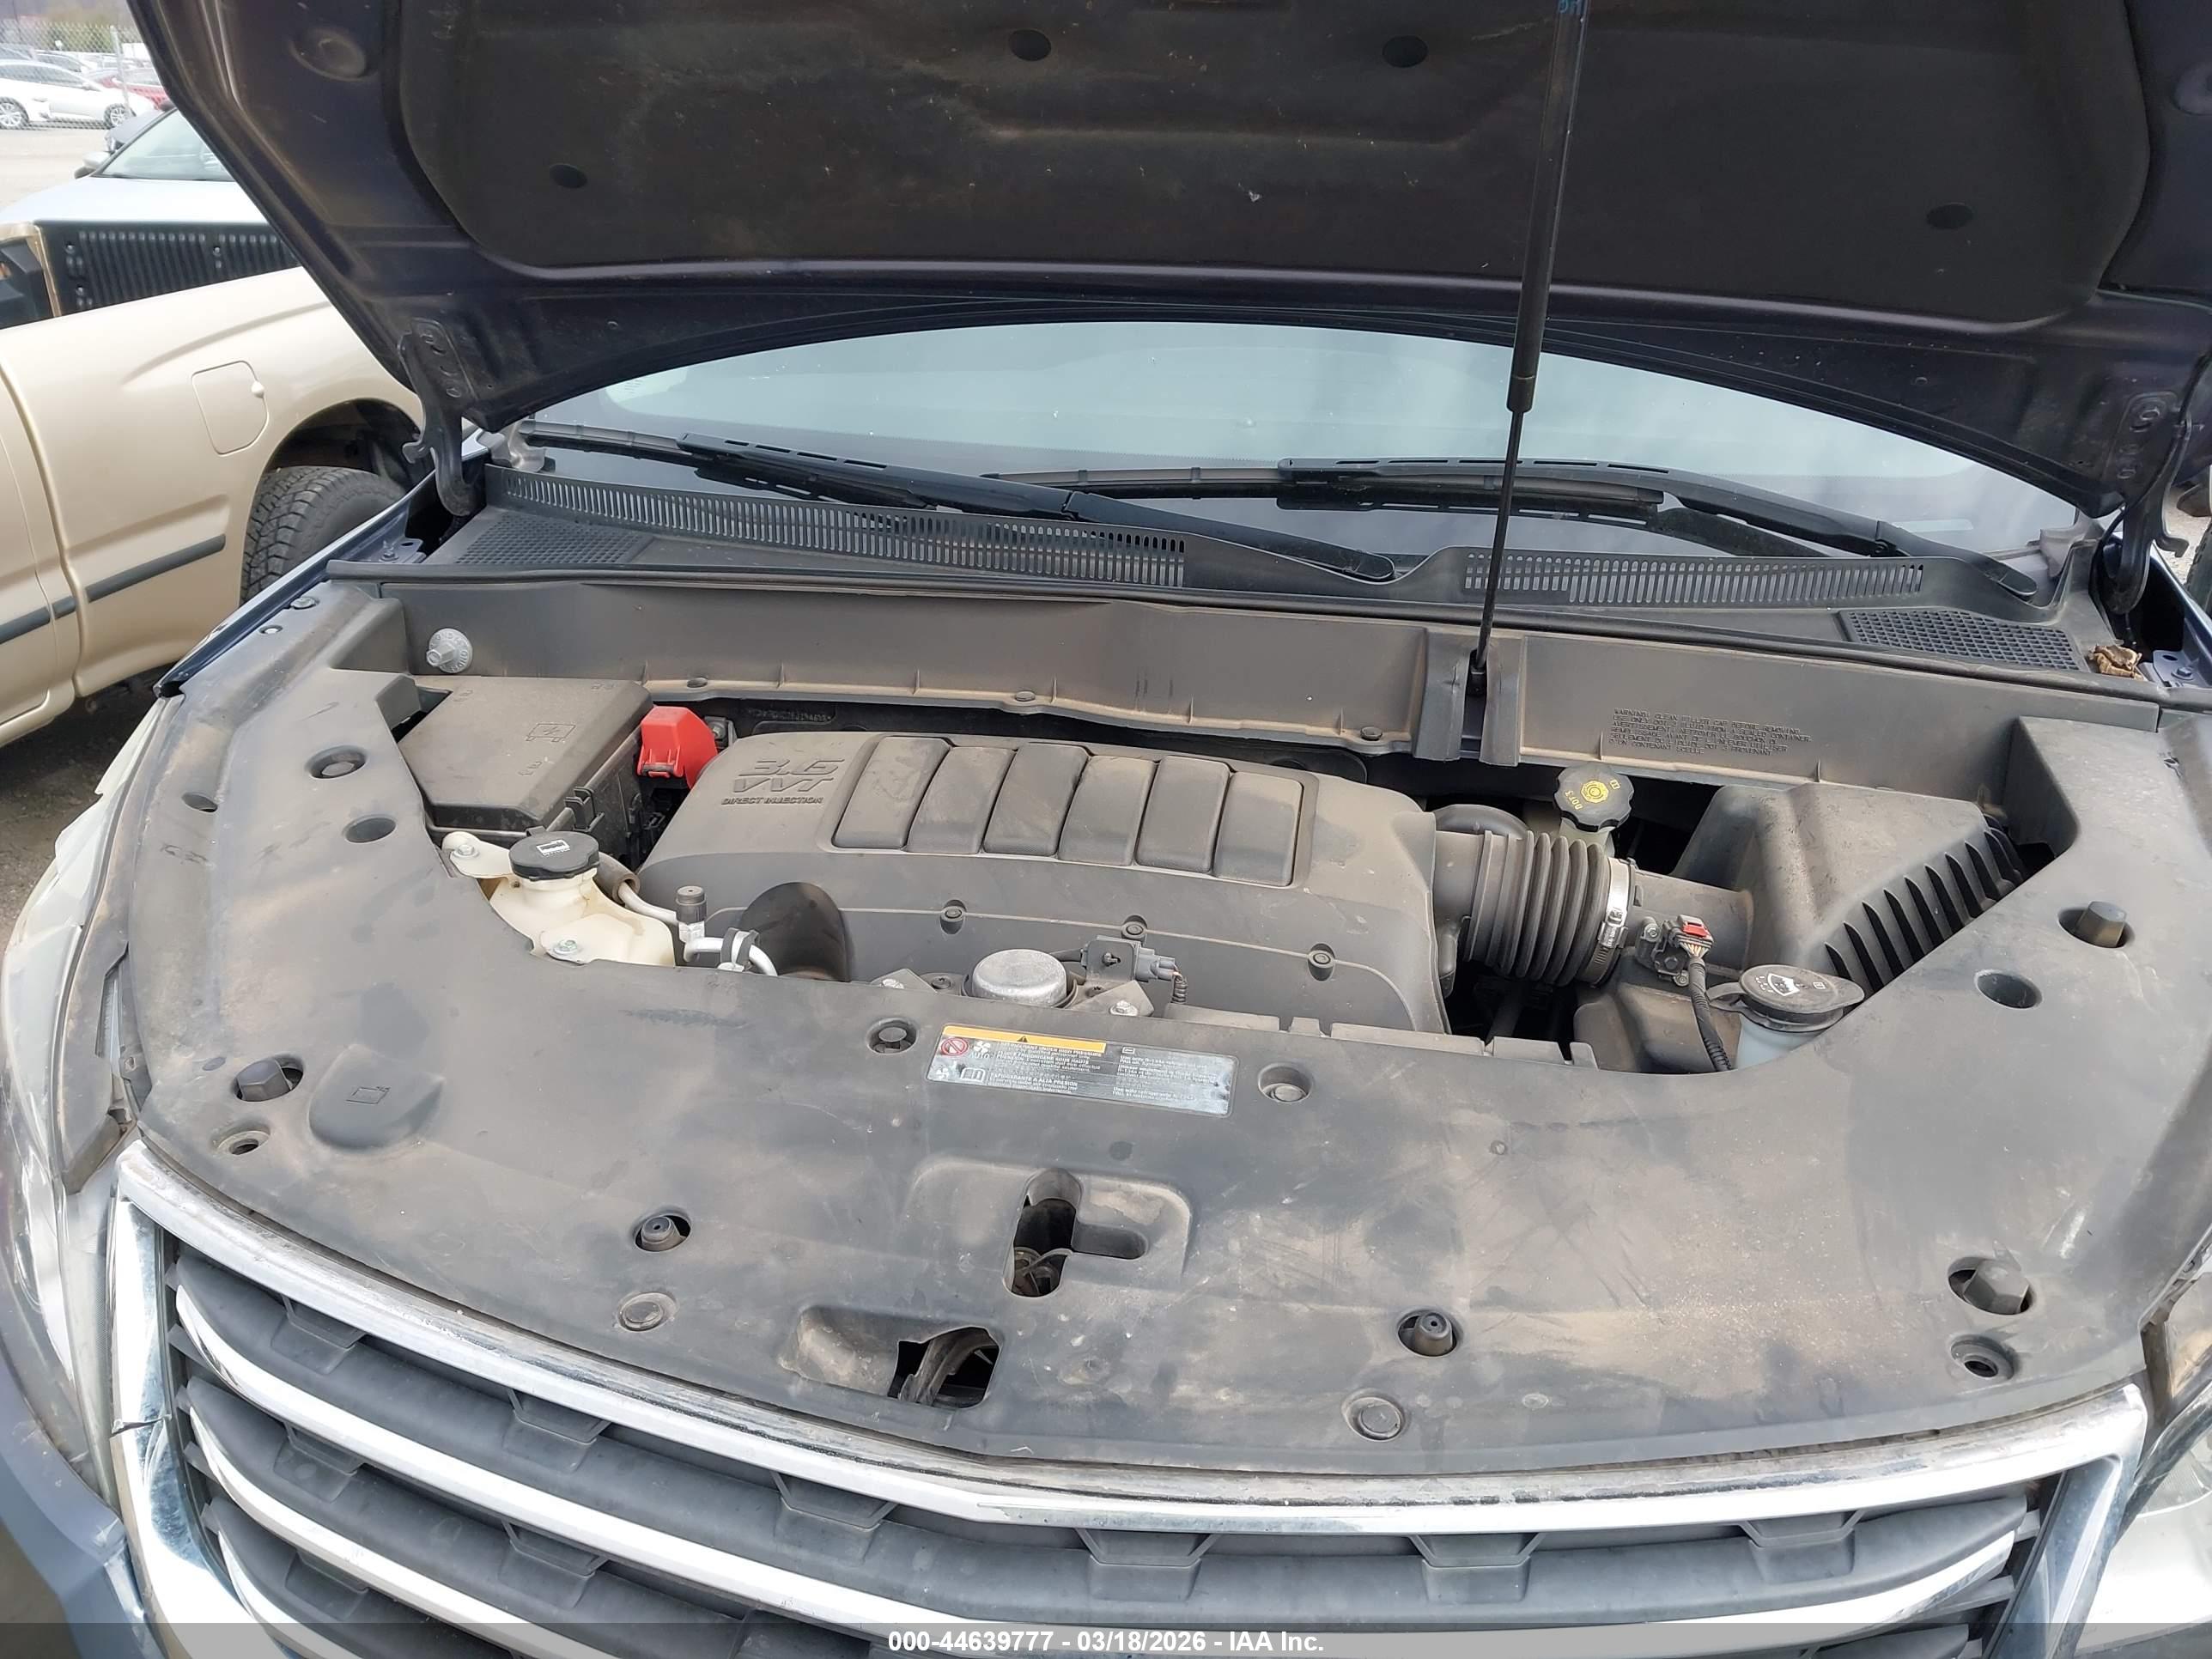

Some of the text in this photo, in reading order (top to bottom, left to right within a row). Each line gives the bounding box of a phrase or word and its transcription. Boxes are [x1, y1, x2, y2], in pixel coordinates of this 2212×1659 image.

[738, 759, 845, 776] 3.6
[733, 778, 834, 793] VVT
[721, 797, 763, 805] DIRECT
